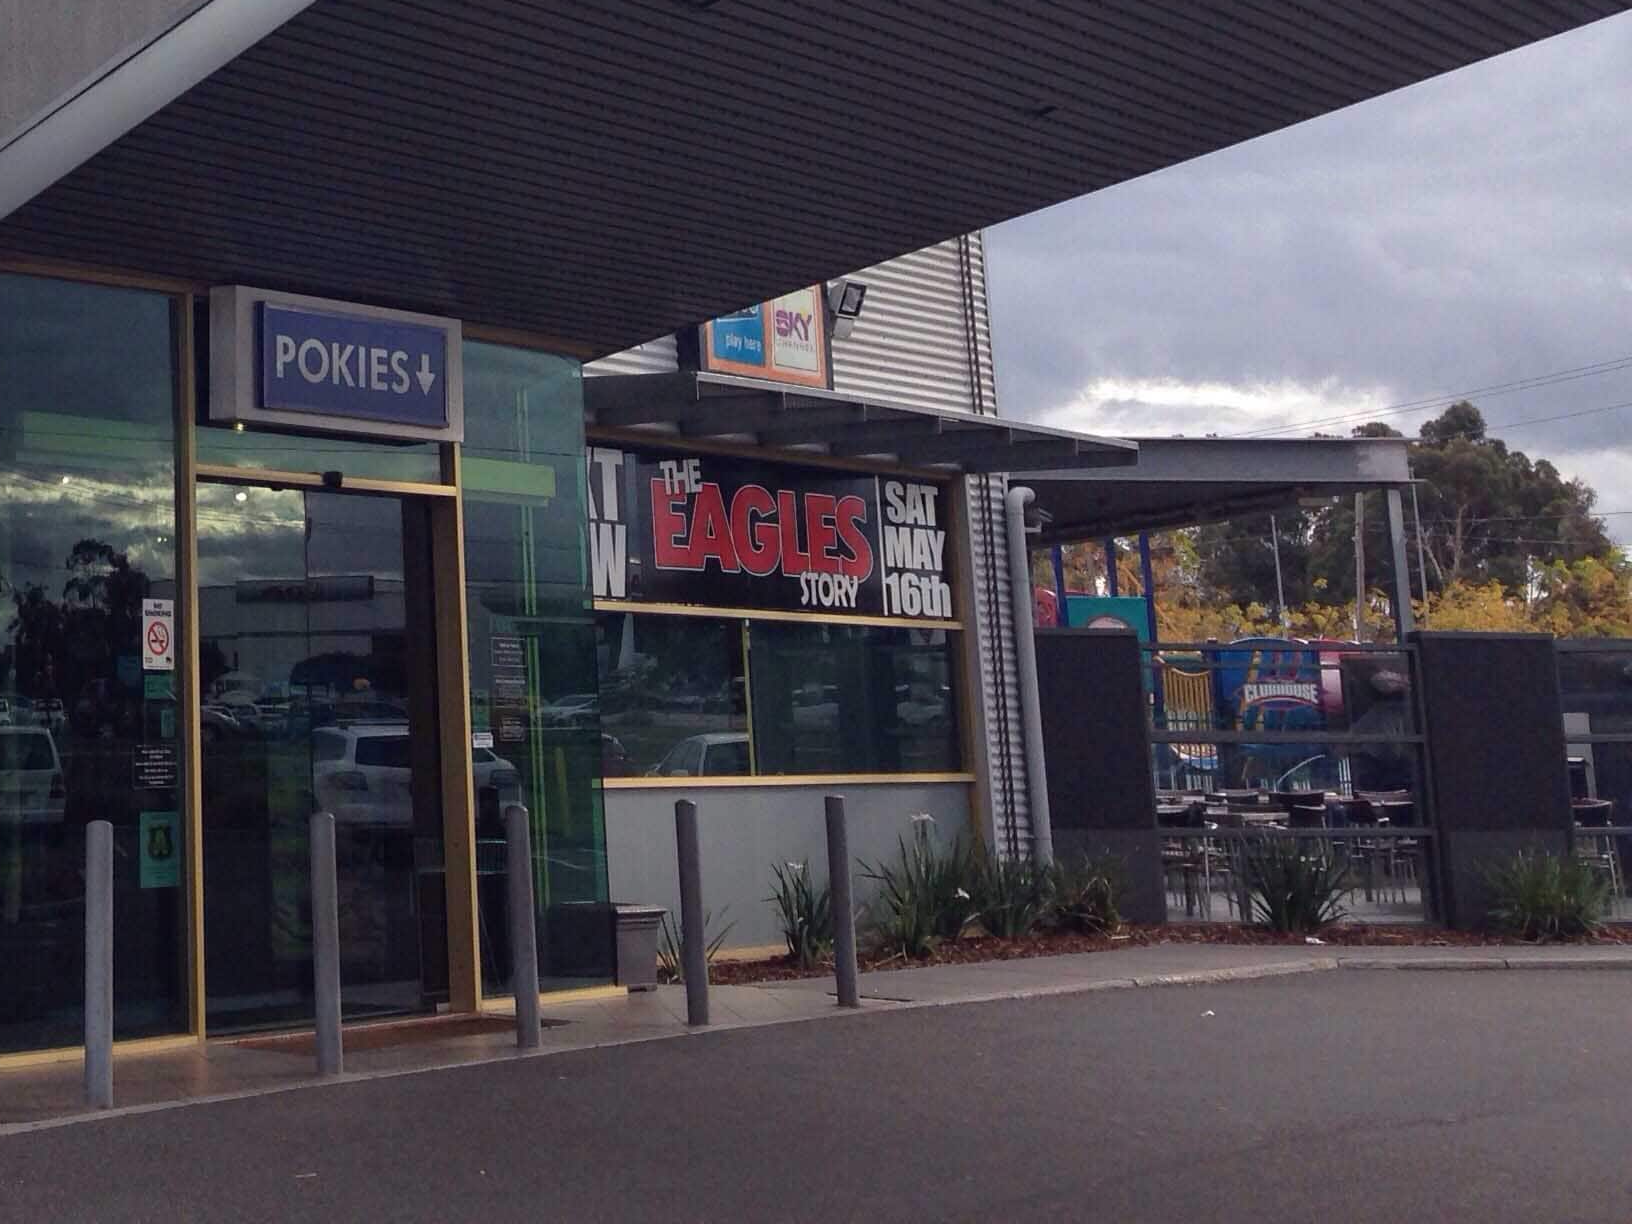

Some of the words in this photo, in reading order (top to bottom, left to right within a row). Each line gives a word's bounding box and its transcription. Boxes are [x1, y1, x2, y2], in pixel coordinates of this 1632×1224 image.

[775, 309, 813, 342] SKY
[275, 335, 411, 395] POKIES
[659, 458, 704, 495] THE
[885, 480, 939, 527] SAT
[651, 477, 874, 584] EAGLES
[884, 526, 946, 572] MAY
[800, 571, 859, 608] STORY
[885, 573, 953, 618] 16th
[1242, 682, 1319, 705] CLUBHOUSE
